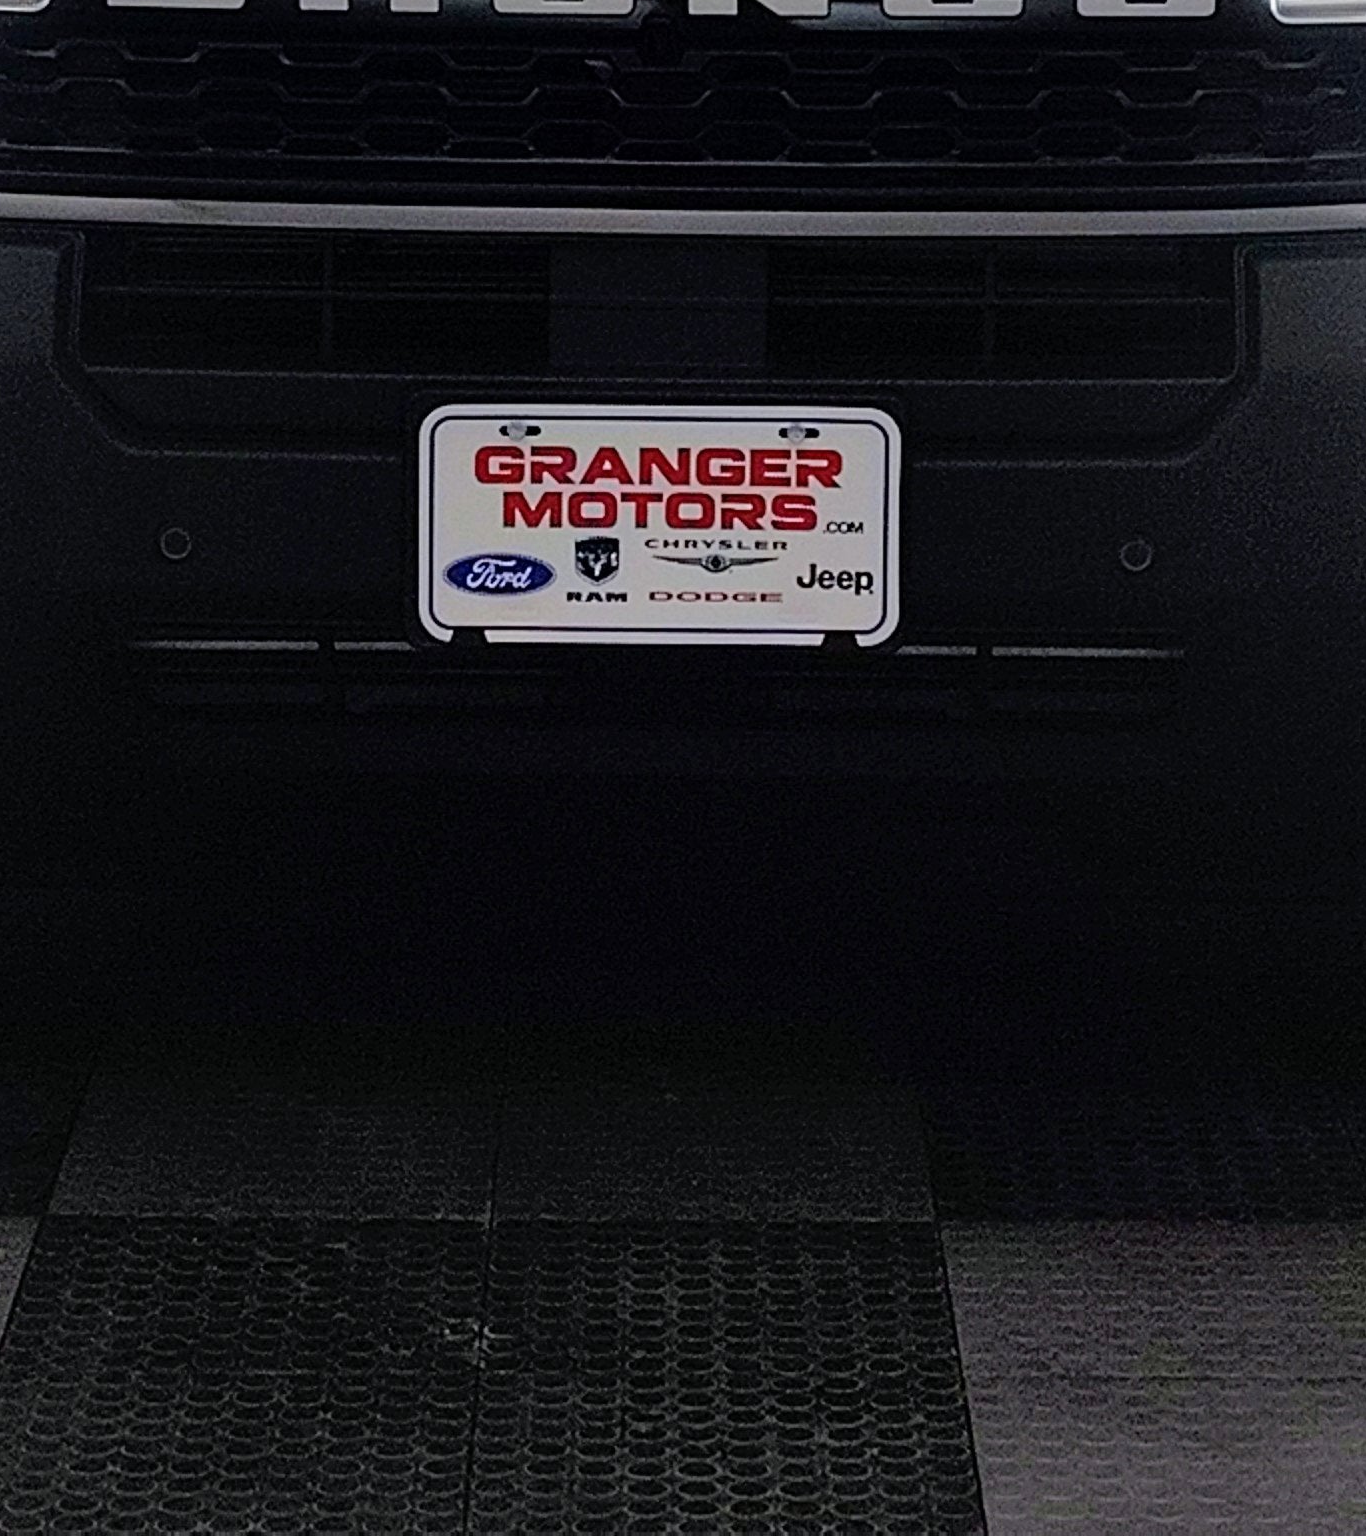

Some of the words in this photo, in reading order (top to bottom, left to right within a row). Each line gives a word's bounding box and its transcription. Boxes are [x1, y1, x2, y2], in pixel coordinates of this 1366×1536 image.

[475, 445, 843, 488] GRANGER
[502, 491, 818, 531] MOTORS
[823, 521, 865, 534] .COM
[644, 538, 788, 551] CHRYSLER
[466, 559, 532, 589] Ford
[796, 564, 874, 596] Jeep
[566, 591, 628, 603] RAM
[648, 591, 784, 604] DODGE
